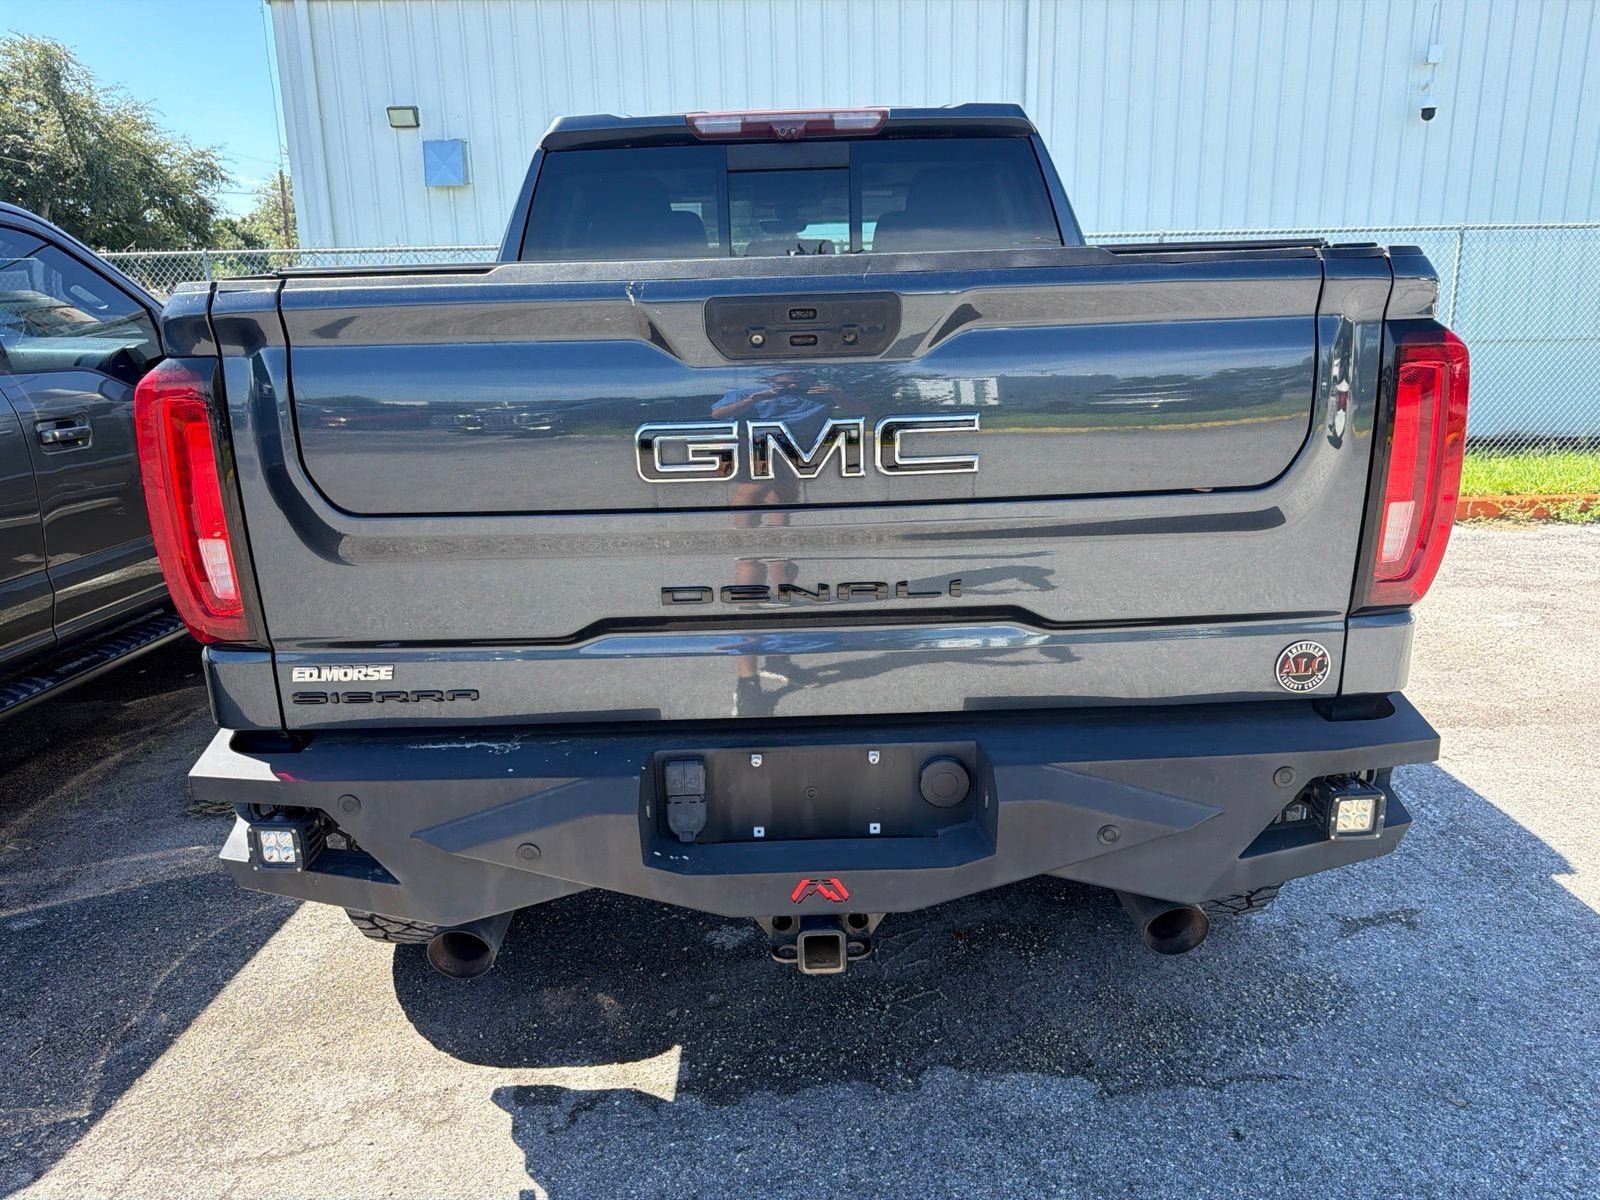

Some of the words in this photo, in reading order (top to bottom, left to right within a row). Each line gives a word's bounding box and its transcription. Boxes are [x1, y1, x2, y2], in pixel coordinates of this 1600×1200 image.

[634, 412, 980, 483] GMC
[661, 578, 962, 606] DENALI
[1286, 643, 1324, 658] AMERICAN
[1280, 656, 1328, 675] ALC
[291, 688, 480, 705] SIERRA
